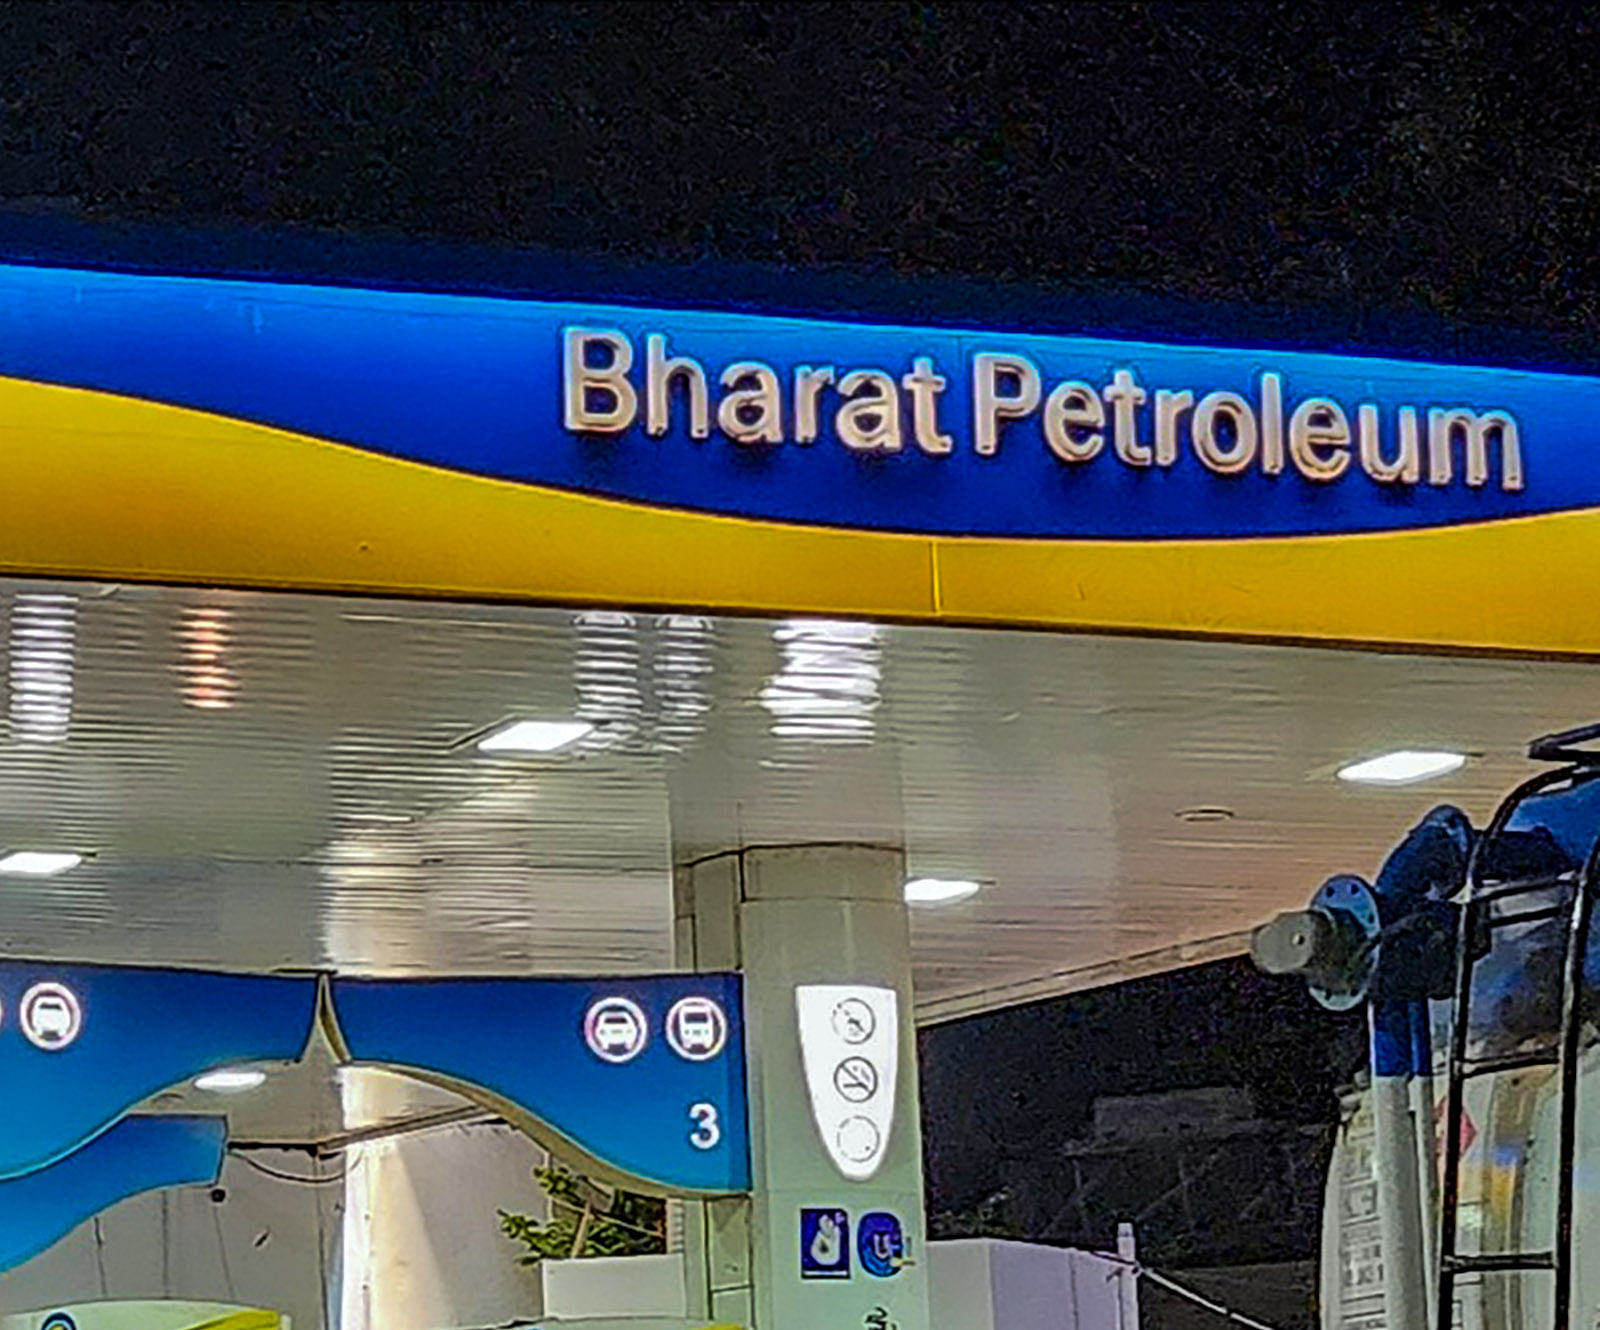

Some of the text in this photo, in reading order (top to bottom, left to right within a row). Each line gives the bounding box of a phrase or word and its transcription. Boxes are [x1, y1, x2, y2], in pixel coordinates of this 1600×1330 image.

[563, 325, 1523, 491] Bharat Petroleum
[690, 1103, 720, 1149] 3
